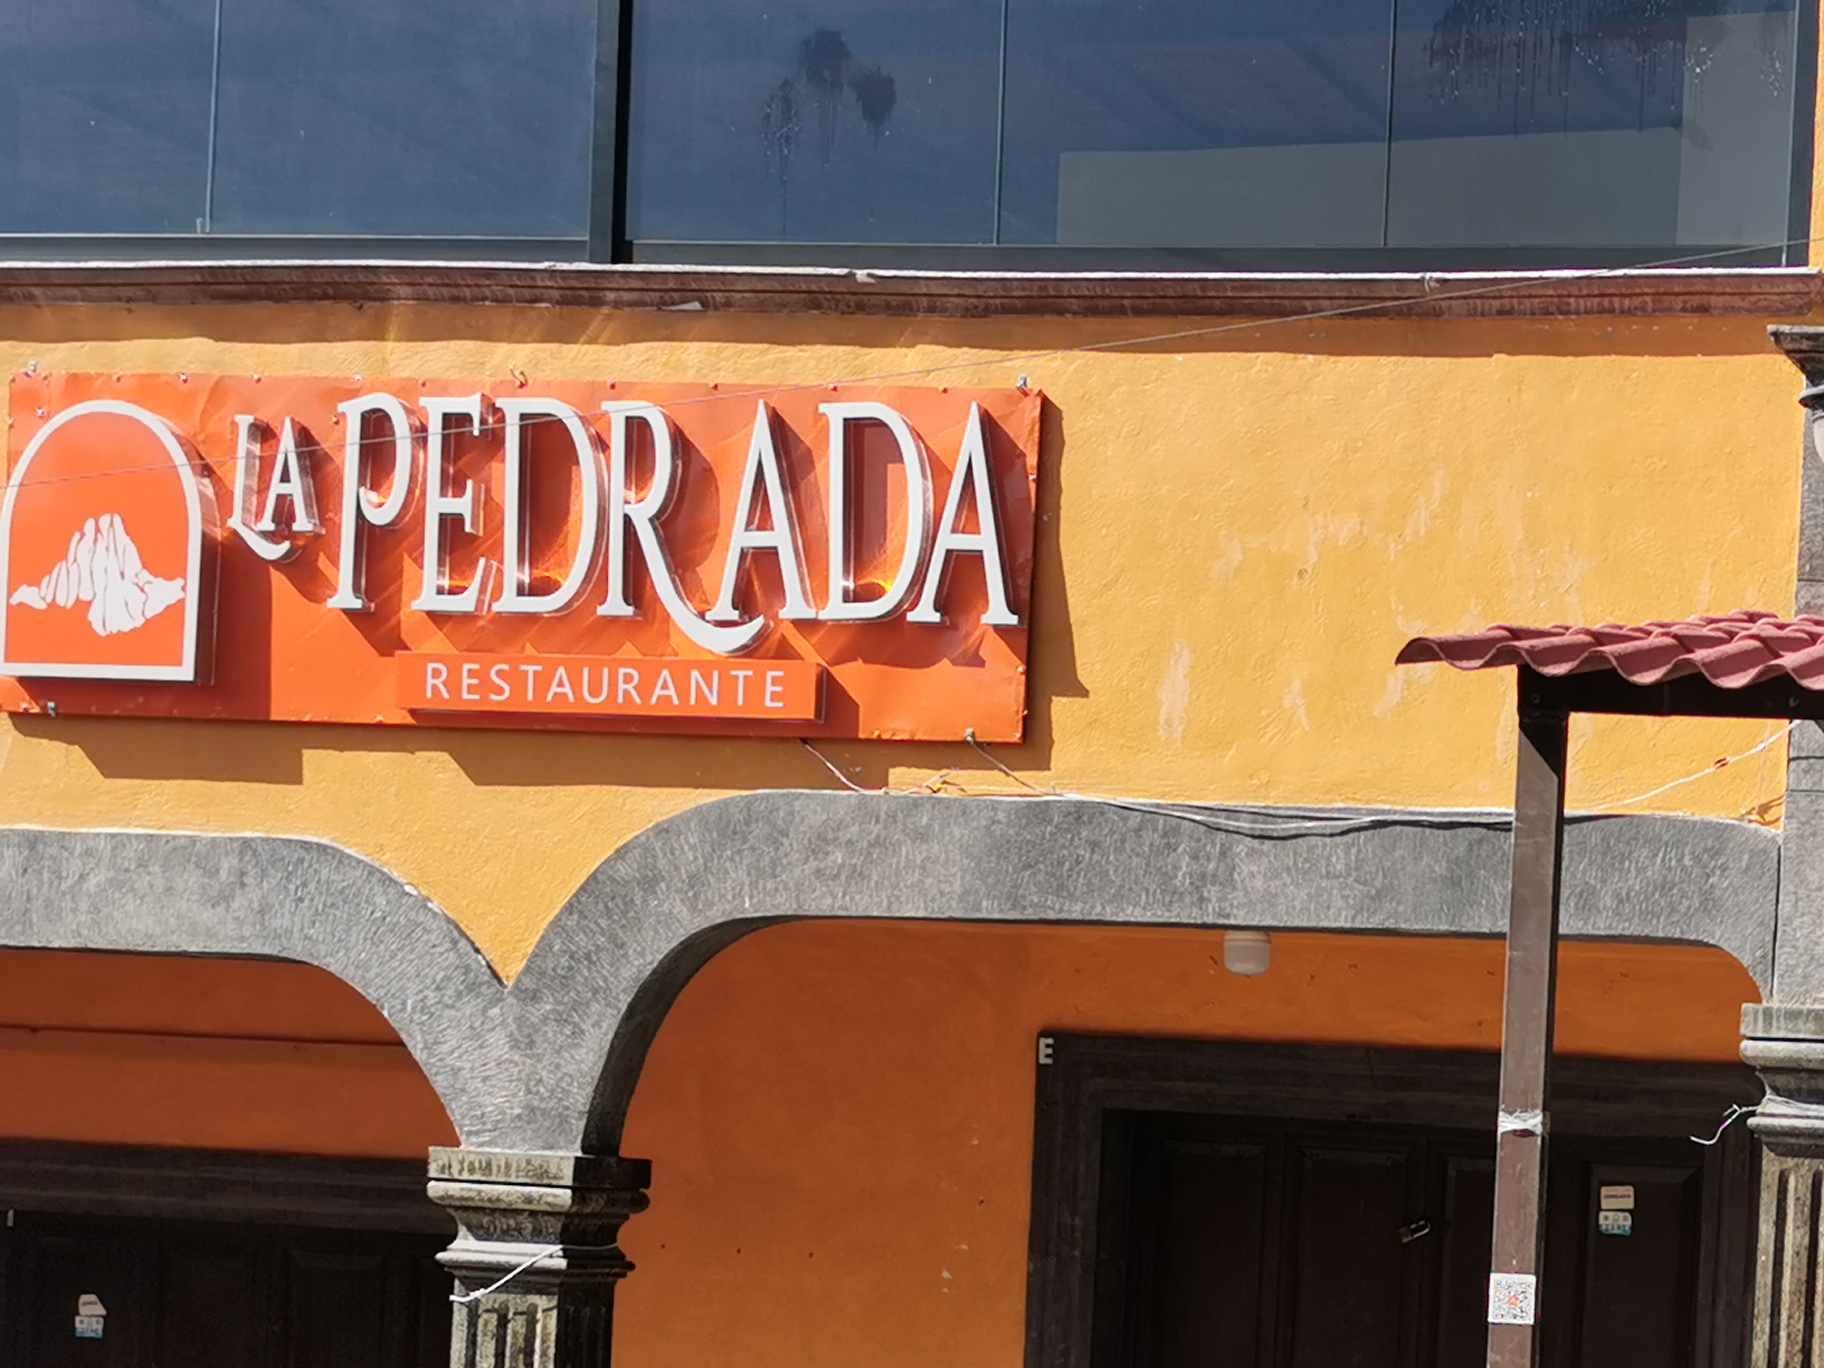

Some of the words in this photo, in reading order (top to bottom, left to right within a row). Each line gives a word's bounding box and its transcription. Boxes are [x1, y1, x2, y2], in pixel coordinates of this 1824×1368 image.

[227, 413, 317, 561] LA
[326, 391, 1020, 655] PEDRADA
[425, 662, 786, 709] RESTAURANTE
[1038, 1037, 1055, 1065] E
